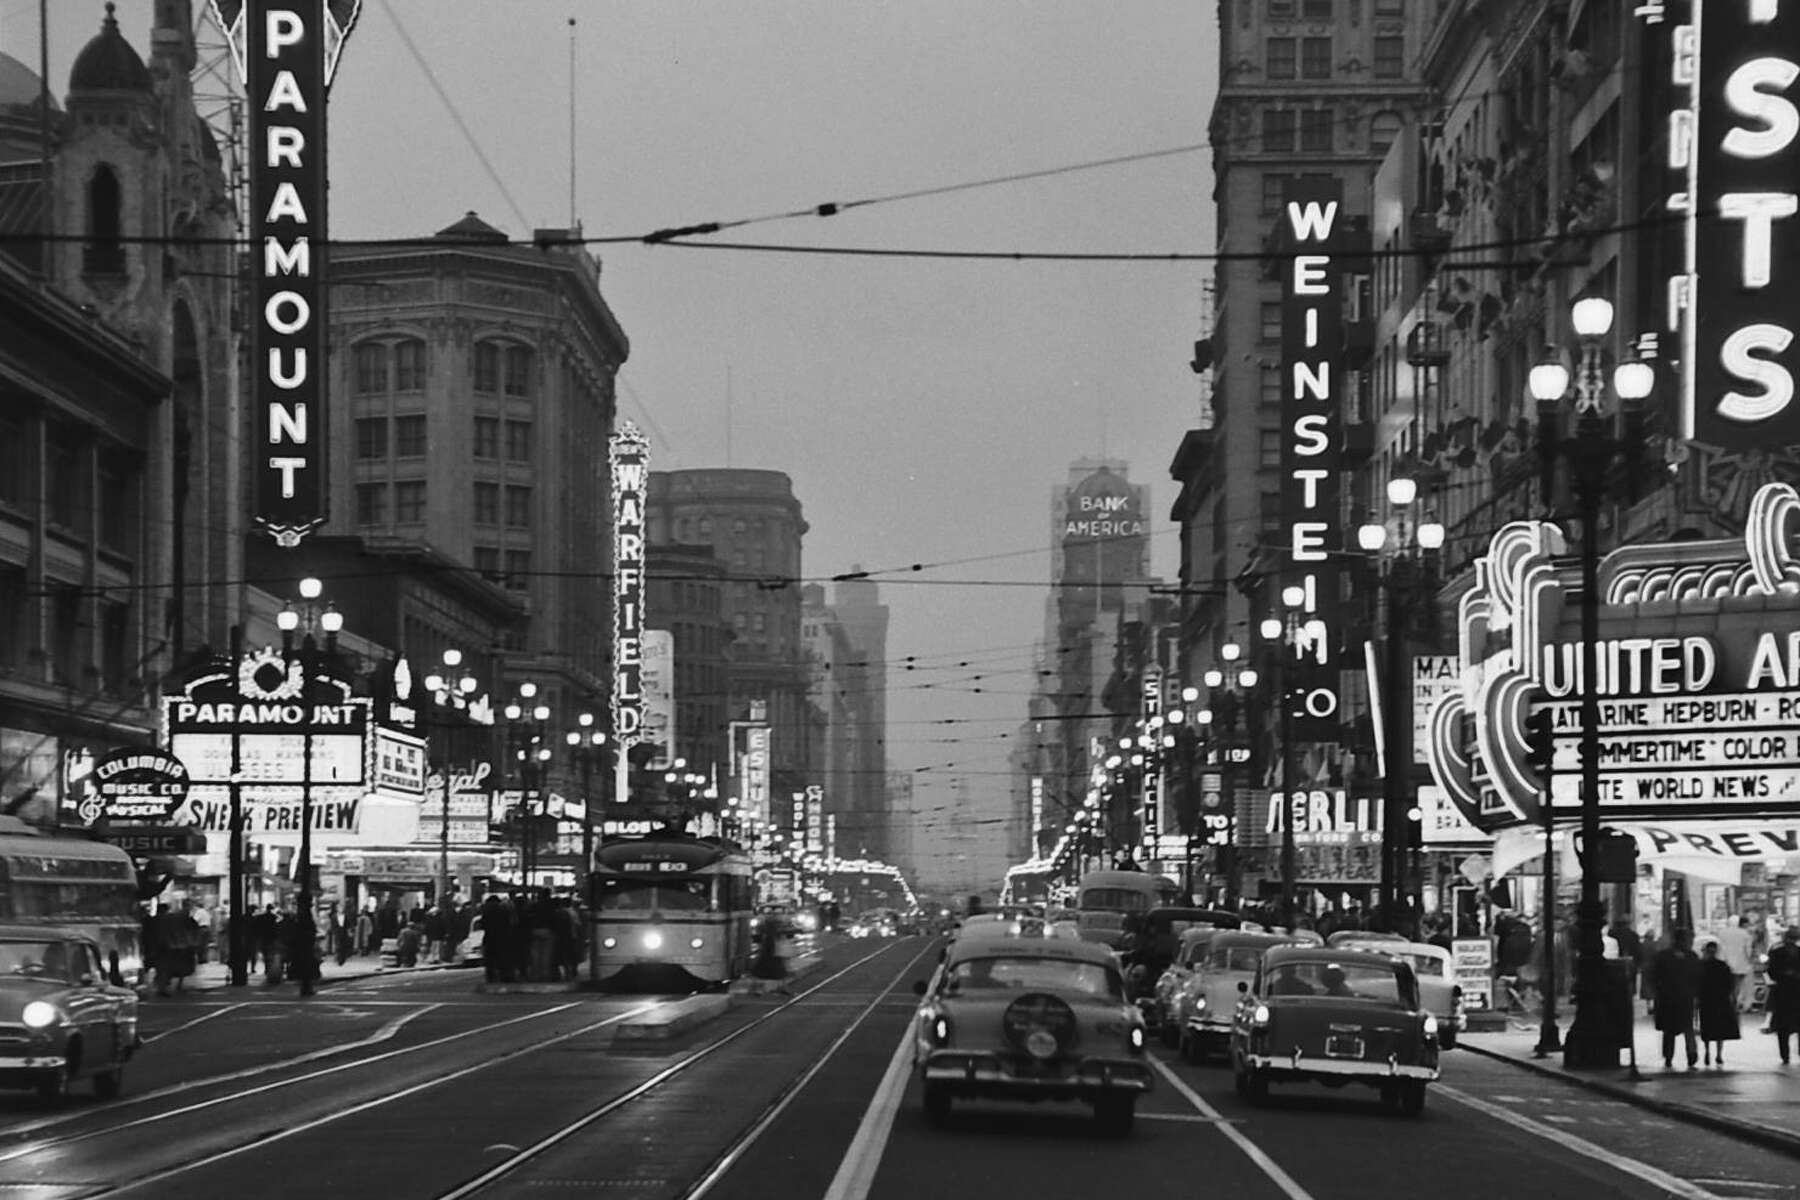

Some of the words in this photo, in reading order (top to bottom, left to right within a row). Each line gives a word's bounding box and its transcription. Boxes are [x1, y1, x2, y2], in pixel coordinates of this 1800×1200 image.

[1718, 0, 1800, 420] STS
[264, 10, 310, 498] PARAMOUNT
[1081, 496, 1128, 511] BANK
[1066, 520, 1142, 536] AMERICA
[617, 464, 642, 734] WARFIELD
[1416, 658, 1460, 679] MA
[1663, 700, 1757, 724] HEPBURN
[1723, 736, 1787, 761] COLOR
[97, 755, 184, 780] COLUMBIA
[102, 783, 154, 795] MUSIC
[1637, 777, 1704, 801] WORLD
[1713, 774, 1770, 799] NEWS
[189, 799, 254, 831] SNEK
